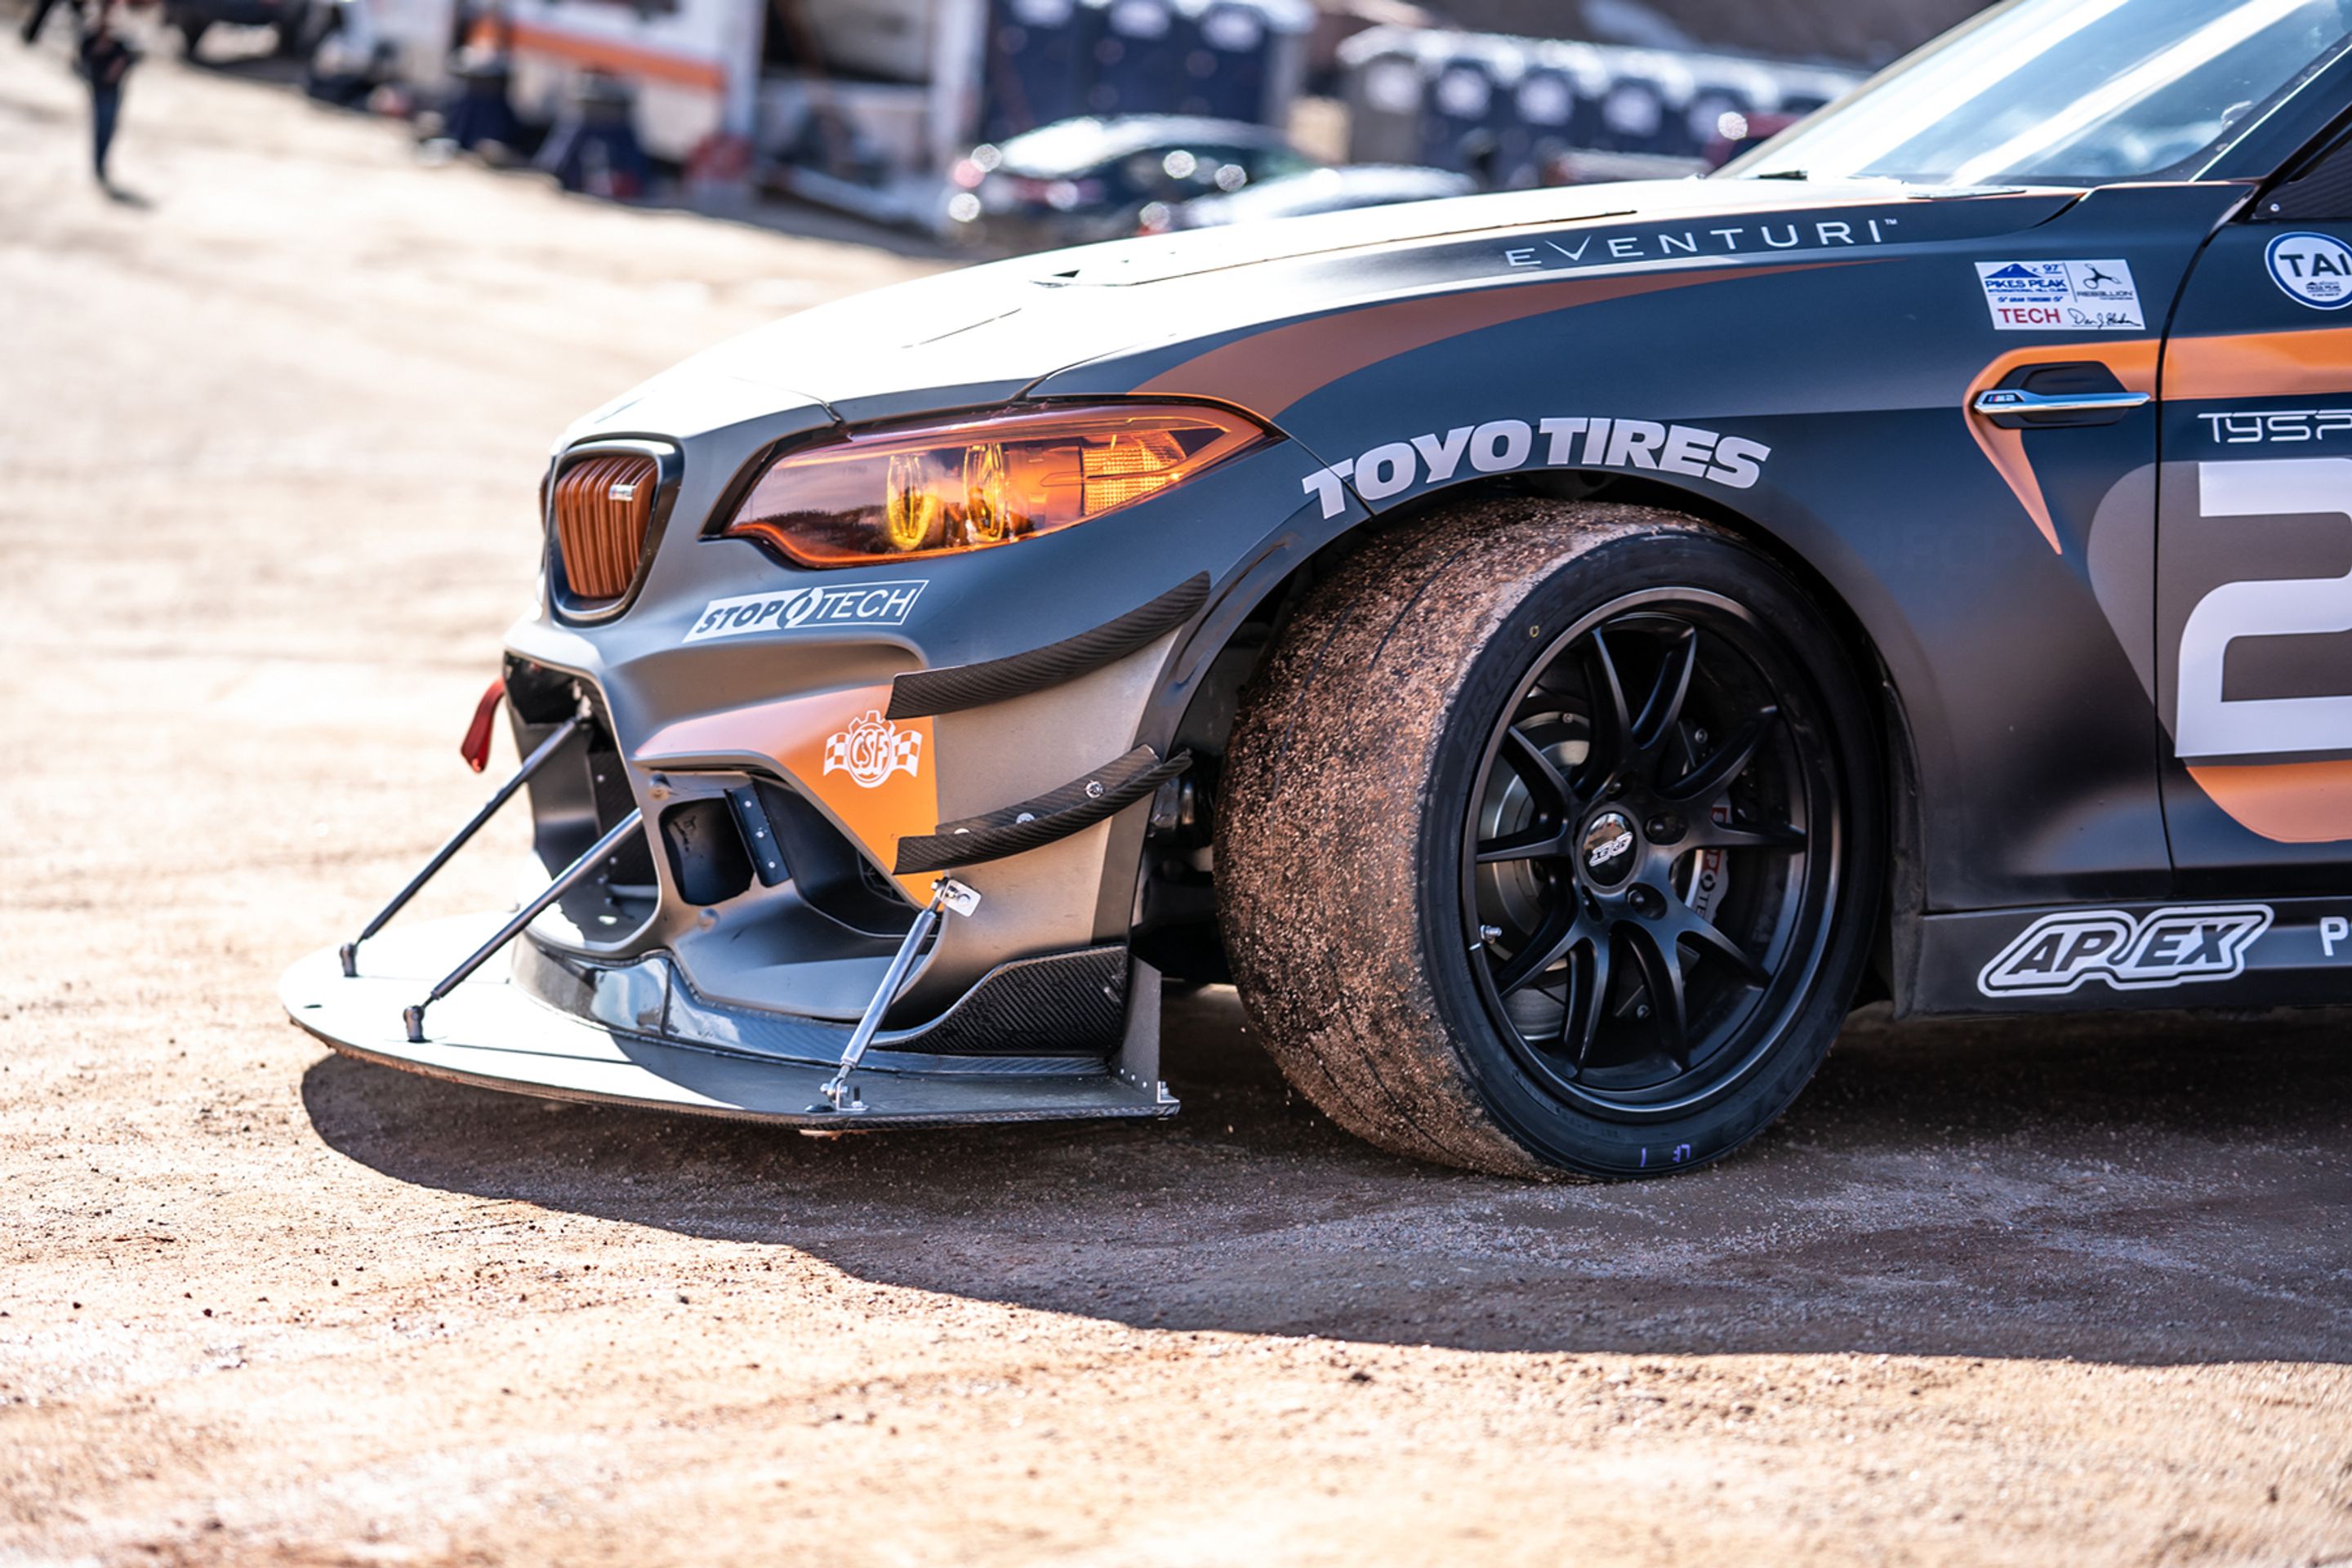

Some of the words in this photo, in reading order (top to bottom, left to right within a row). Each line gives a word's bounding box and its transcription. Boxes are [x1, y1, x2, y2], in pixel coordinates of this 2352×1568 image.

[1984, 279, 2026, 288] PIKES
[2029, 278, 2067, 287] PEAK
[1998, 308, 2062, 324] TECH
[1302, 418, 1533, 520] TOYO
[1539, 417, 1772, 489] TIRES
[851, 729, 889, 770] CSF
[1993, 914, 2264, 986] APEX
[2320, 916, 2352, 956] P
